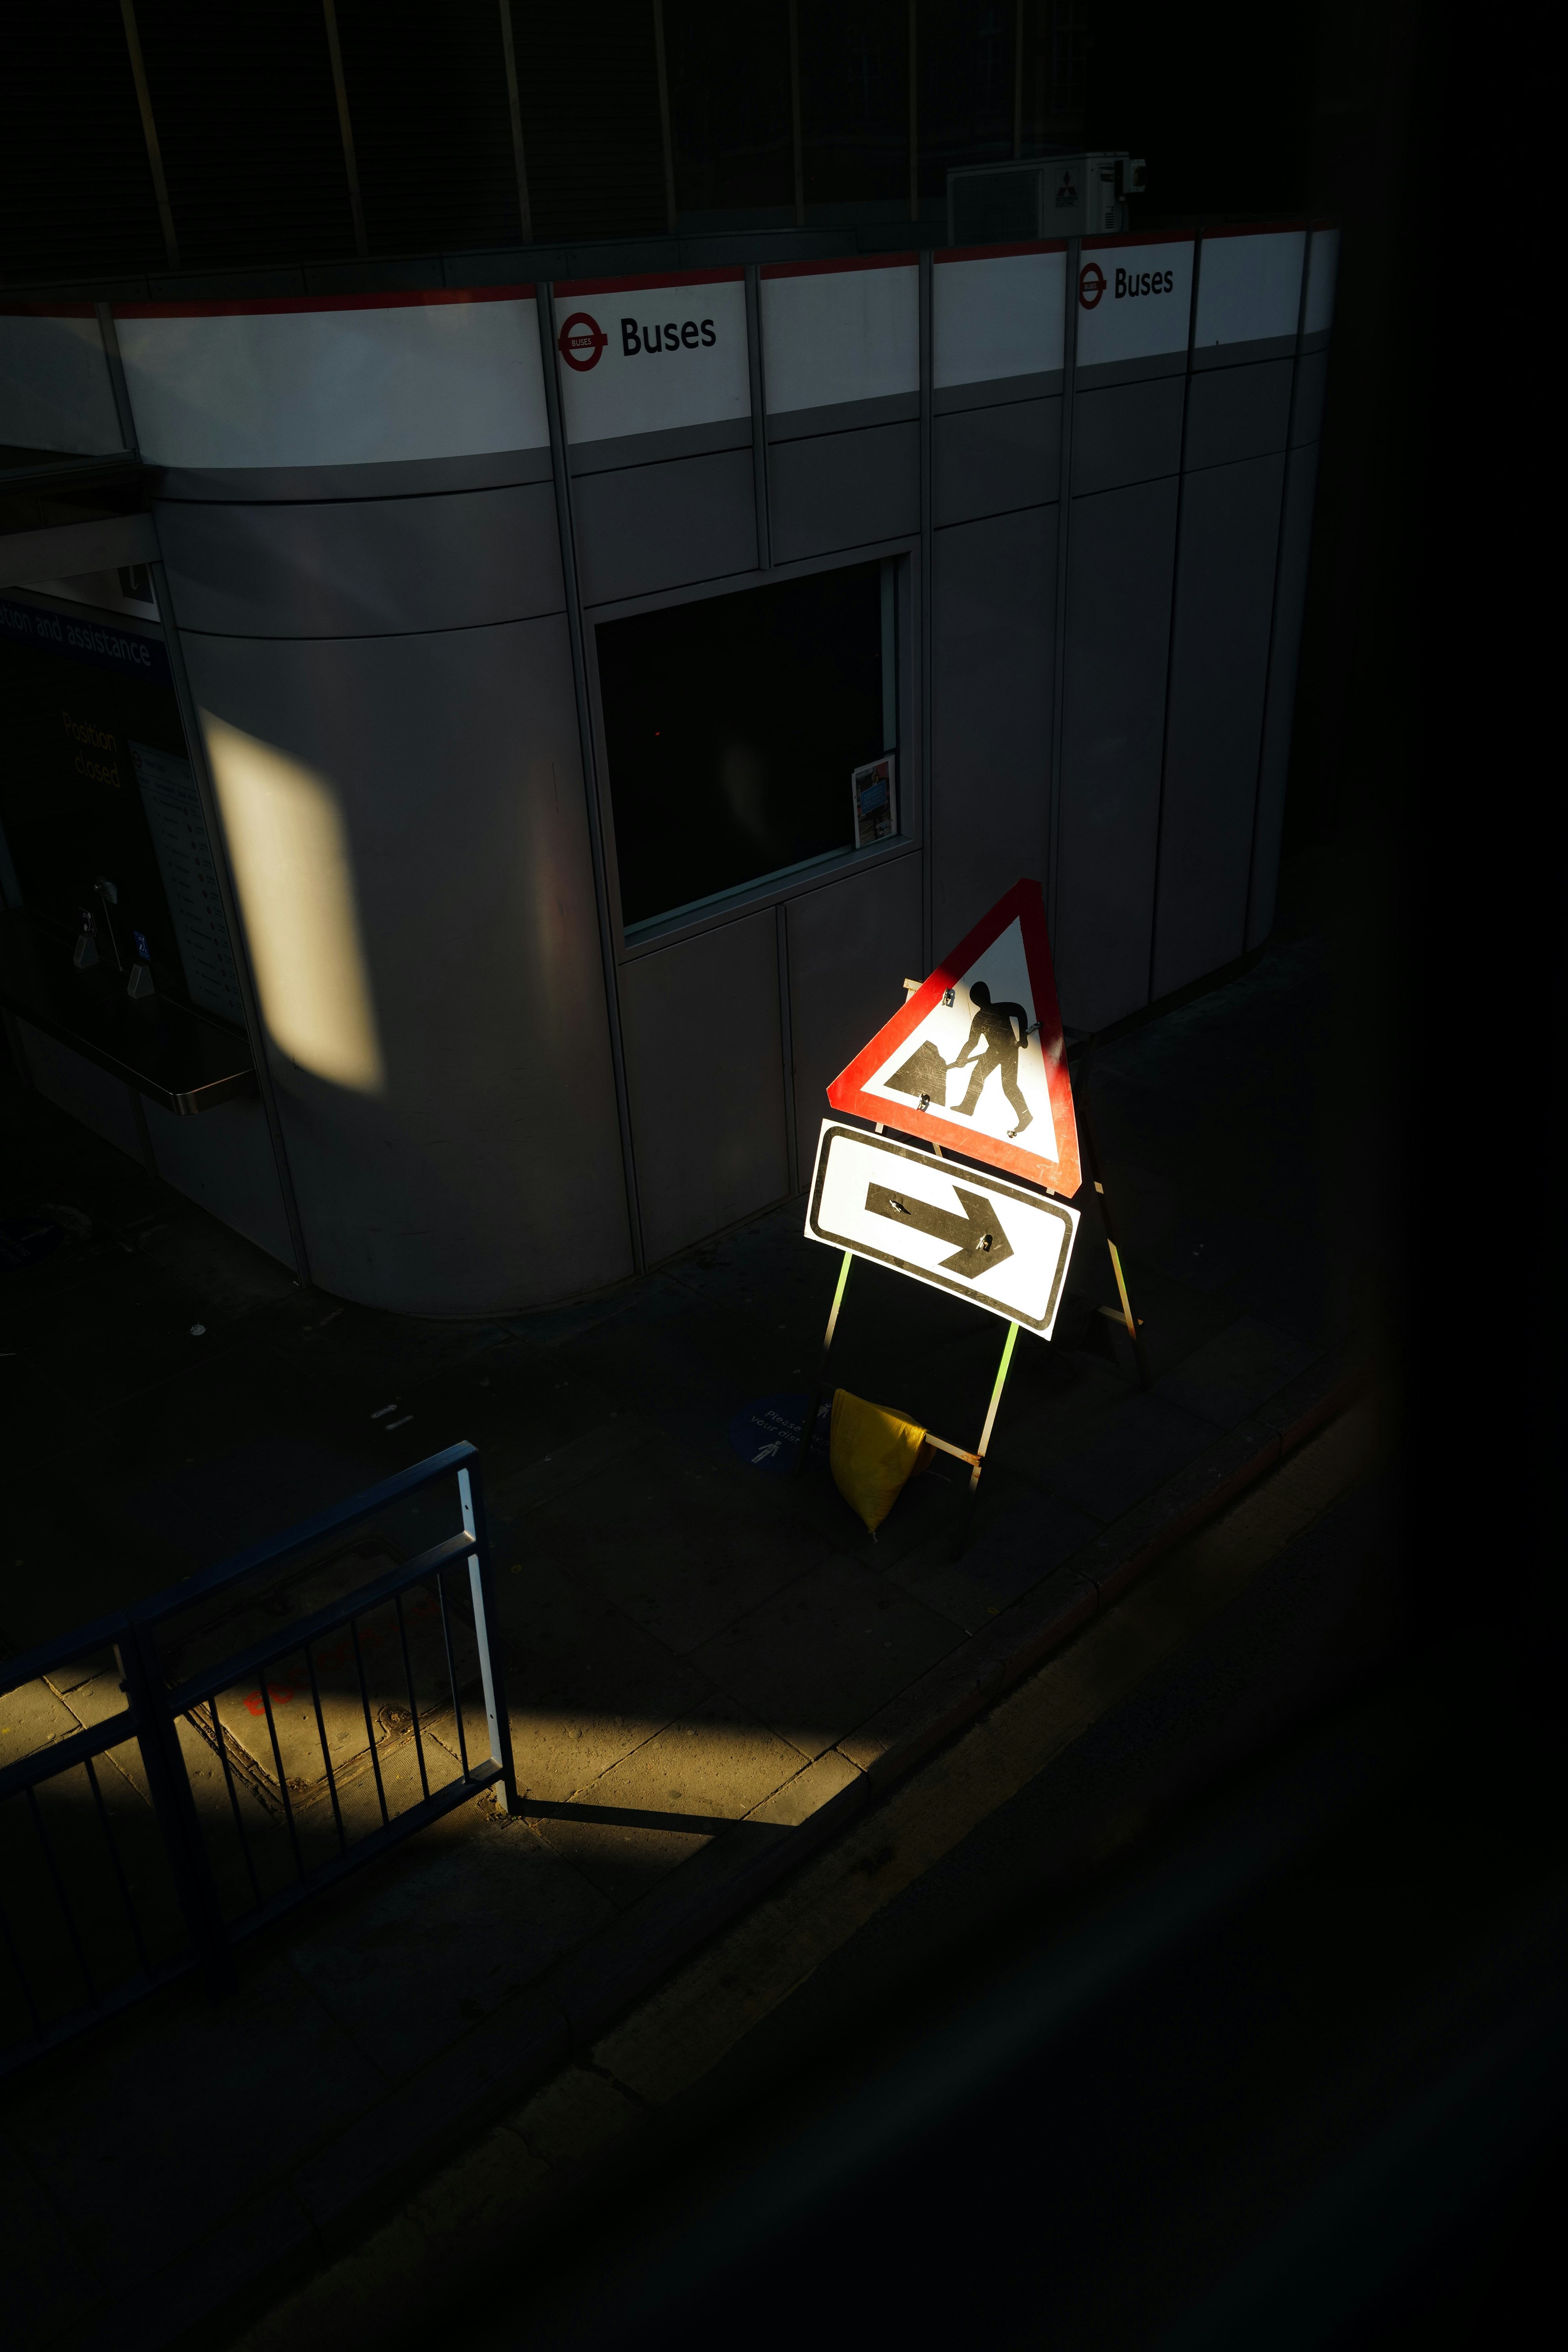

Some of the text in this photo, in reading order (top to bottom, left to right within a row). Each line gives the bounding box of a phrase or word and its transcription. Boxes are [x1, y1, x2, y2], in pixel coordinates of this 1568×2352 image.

[1115, 269, 1173, 298] Buses
[572, 338, 592, 347] BUSES
[621, 318, 716, 356] Buses
[35, 615, 63, 642] and
[66, 623, 151, 666] assistance
[62, 711, 118, 754] Position
[75, 750, 121, 789] closed
[749, 1416, 778, 1431] your
[765, 1410, 802, 1432] Please
